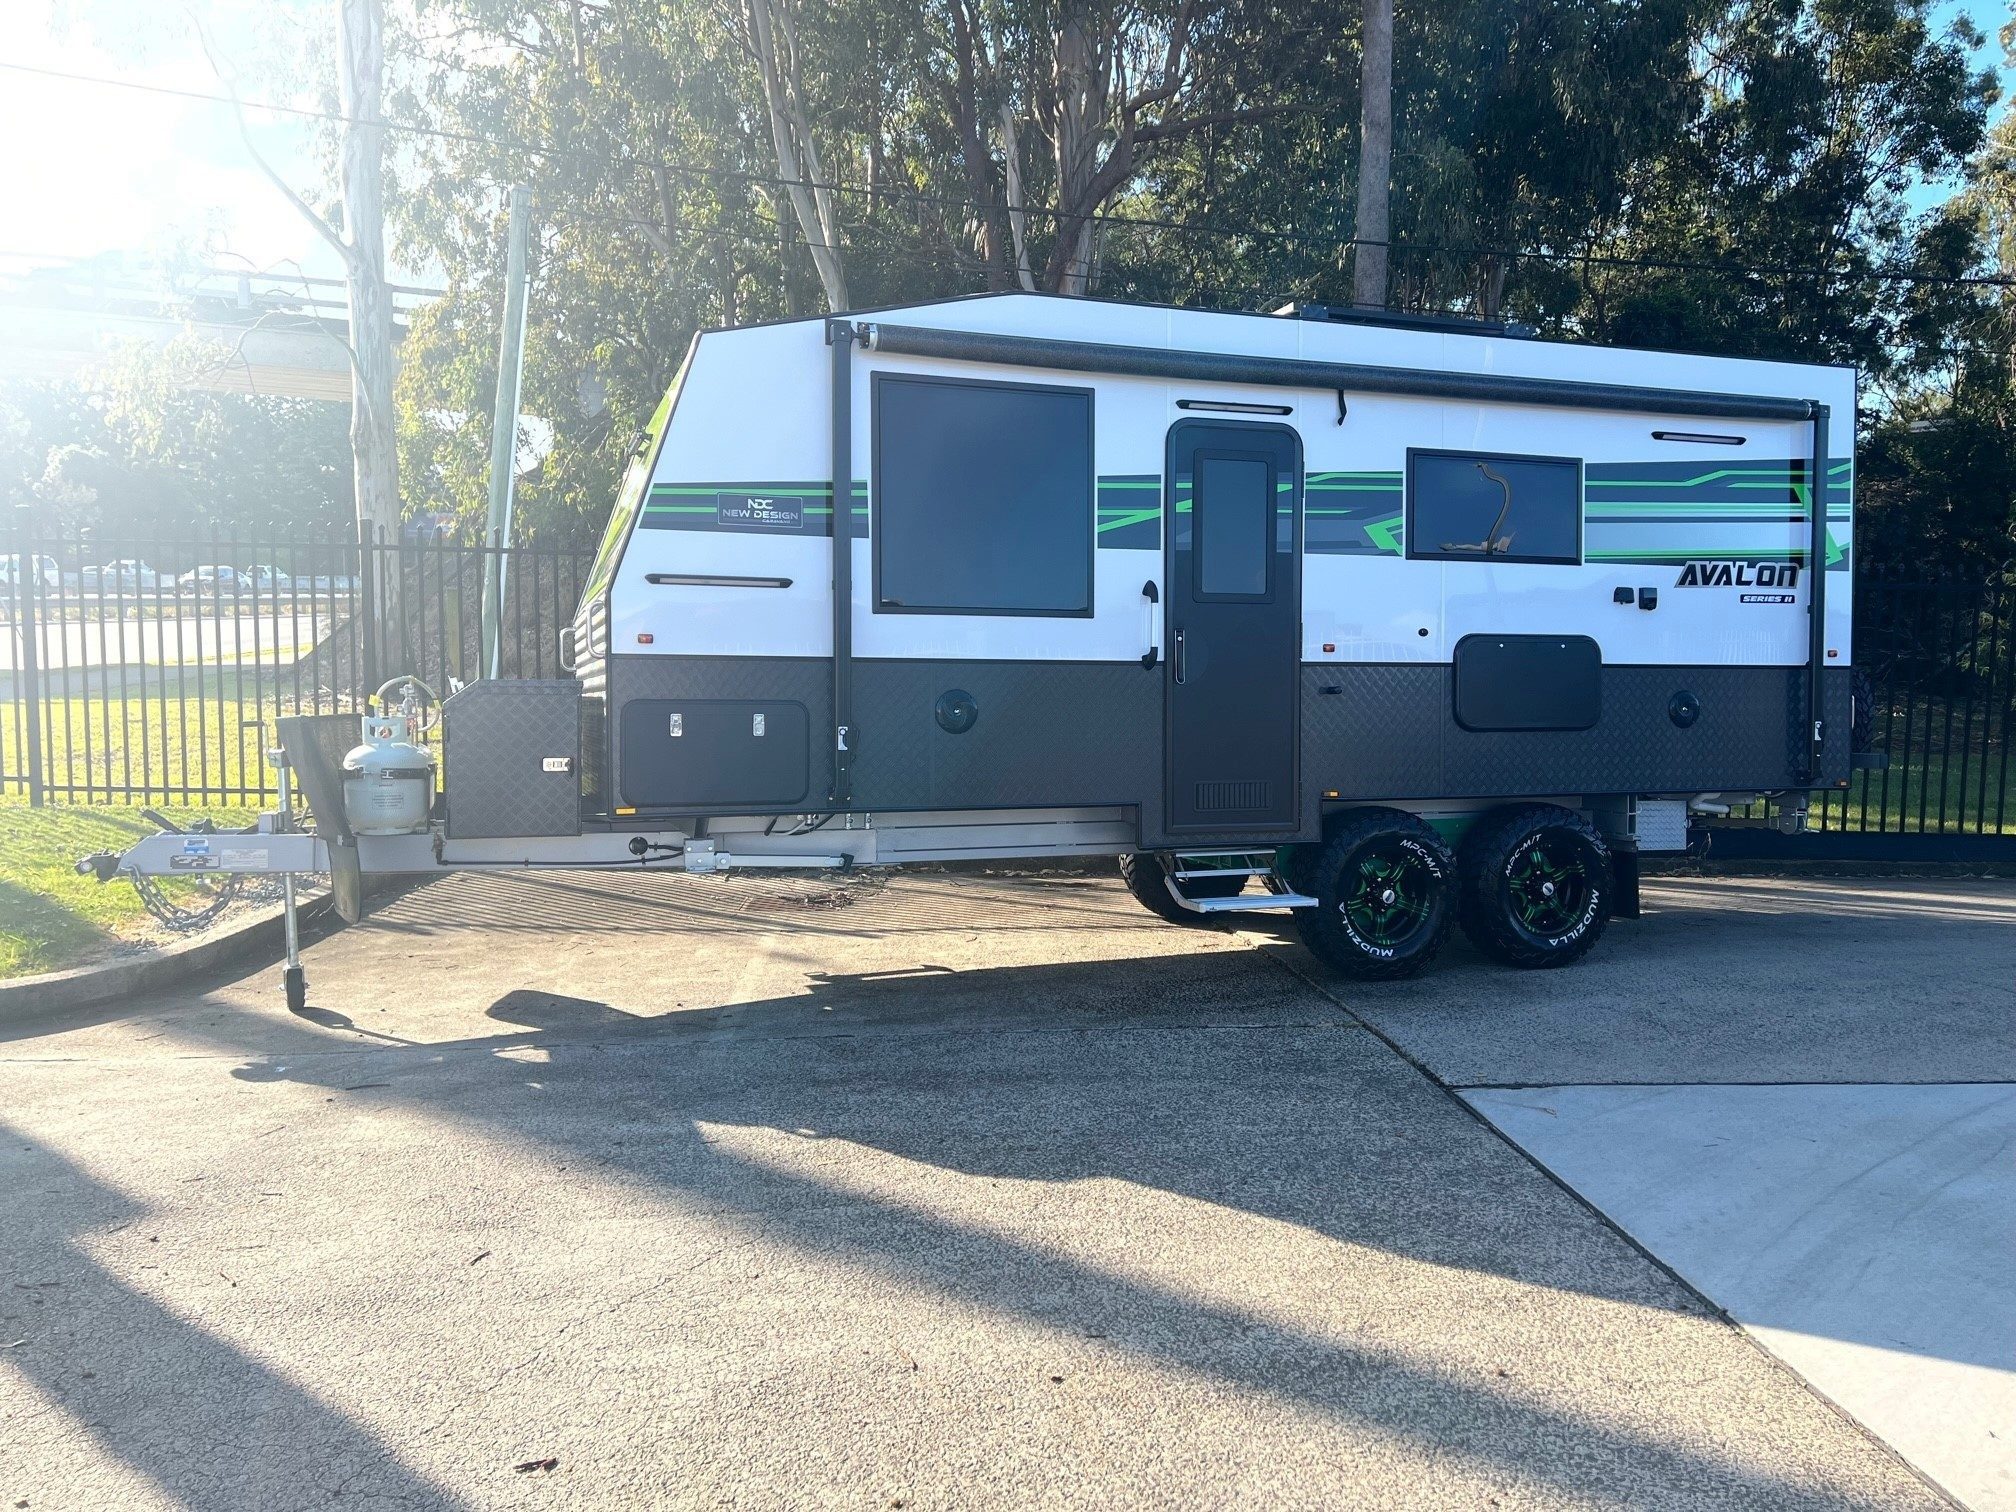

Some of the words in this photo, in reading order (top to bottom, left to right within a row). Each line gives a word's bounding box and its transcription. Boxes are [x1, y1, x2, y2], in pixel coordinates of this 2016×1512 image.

[722, 508, 750, 518] NEW
[753, 510, 799, 520] DESIGN
[747, 498, 774, 510] NDC
[1674, 560, 1799, 589] AVALON
[1338, 901, 1395, 958] MUDZILLA
[1548, 888, 1600, 947] MUDZILLA
